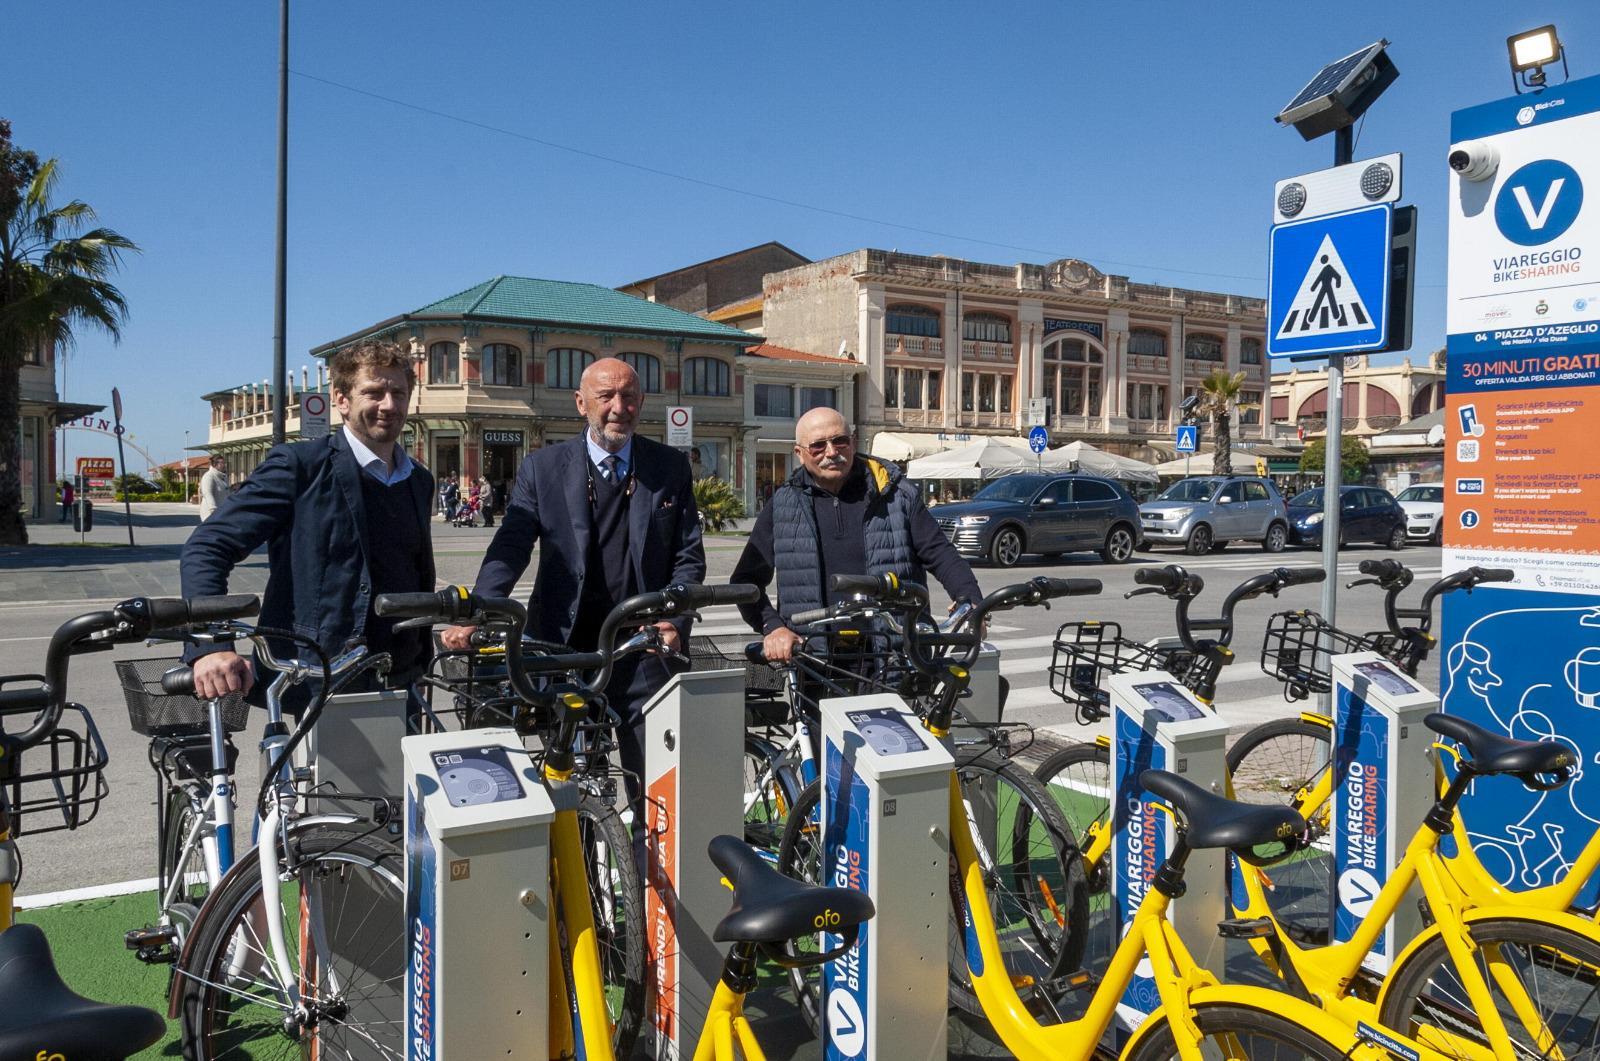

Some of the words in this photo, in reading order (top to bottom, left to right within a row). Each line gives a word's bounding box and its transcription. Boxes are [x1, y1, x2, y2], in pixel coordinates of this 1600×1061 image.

[1512, 178, 1566, 230] V
[1493, 247, 1581, 270] VIAREGGIO
[1493, 262, 1580, 282] BIKESHARING
[1045, 320, 1078, 330] TEATRO
[1474, 333, 1488, 342] 04
[1494, 328, 1534, 340] PIAZZA
[1536, 324, 1598, 336] D'AZEGLIO
[1462, 362, 1481, 378] 30
[1484, 358, 1540, 376] MINUTI
[1475, 377, 1504, 386] OFFERTA
[1505, 376, 1530, 384] VALIDA
[1558, 372, 1596, 380] ABBONATI
[484, 432, 520, 442] GUESS
[80, 460, 112, 468] pizza
[1348, 761, 1364, 864] VIAREGGIO
[1364, 765, 1378, 870] BIKESHARING
[1276, 822, 1292, 837] ofo
[1128, 798, 1143, 915] VIAREGGIO
[1144, 802, 1156, 896] ESHARING
[452, 863, 467, 876] 07
[814, 908, 840, 928] ofo
[656, 920, 666, 996] PRENDI
